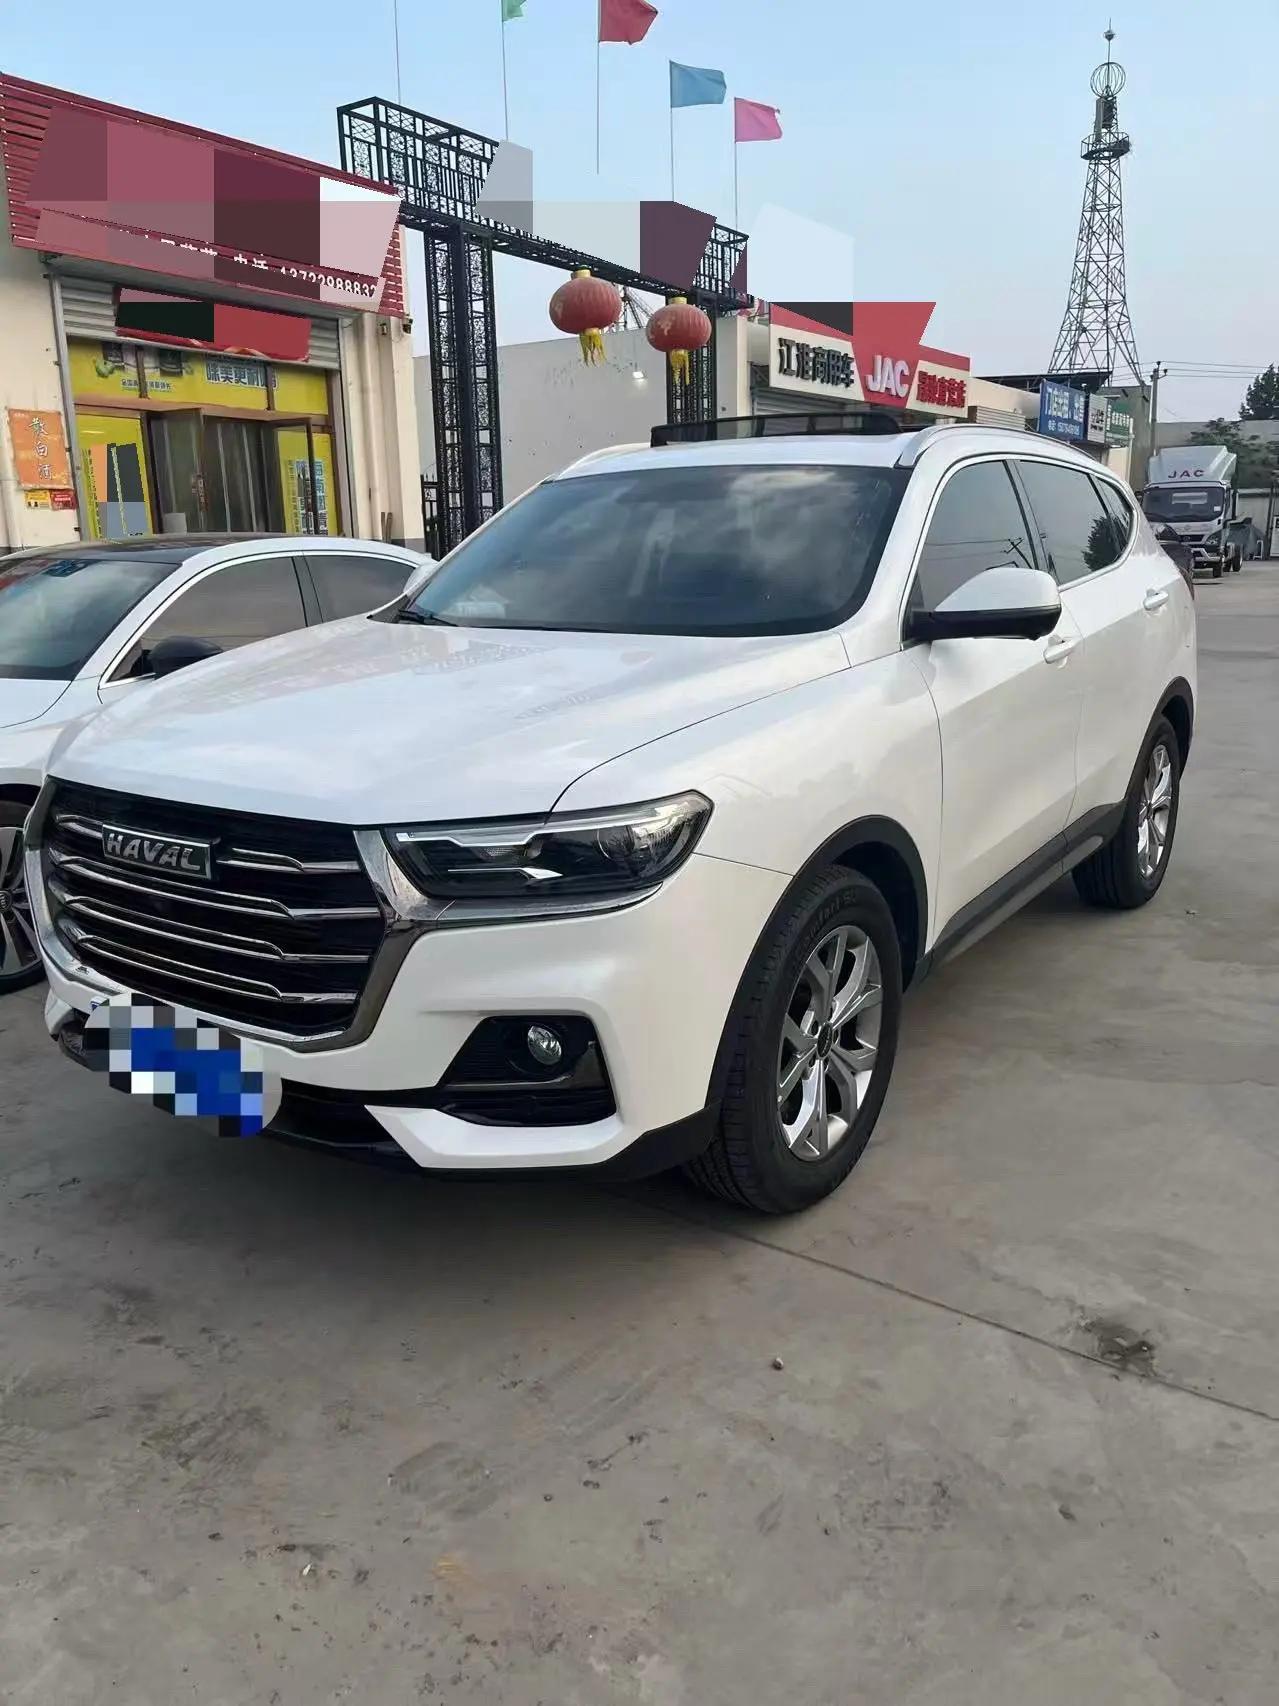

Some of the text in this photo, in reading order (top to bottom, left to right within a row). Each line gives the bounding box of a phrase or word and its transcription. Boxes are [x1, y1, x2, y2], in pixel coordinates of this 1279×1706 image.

[778, 337, 855, 389] 江淮商用车
[864, 354, 910, 399] JAC
[1167, 469, 1205, 479] JAC
[107, 833, 201, 871] HAVAL
